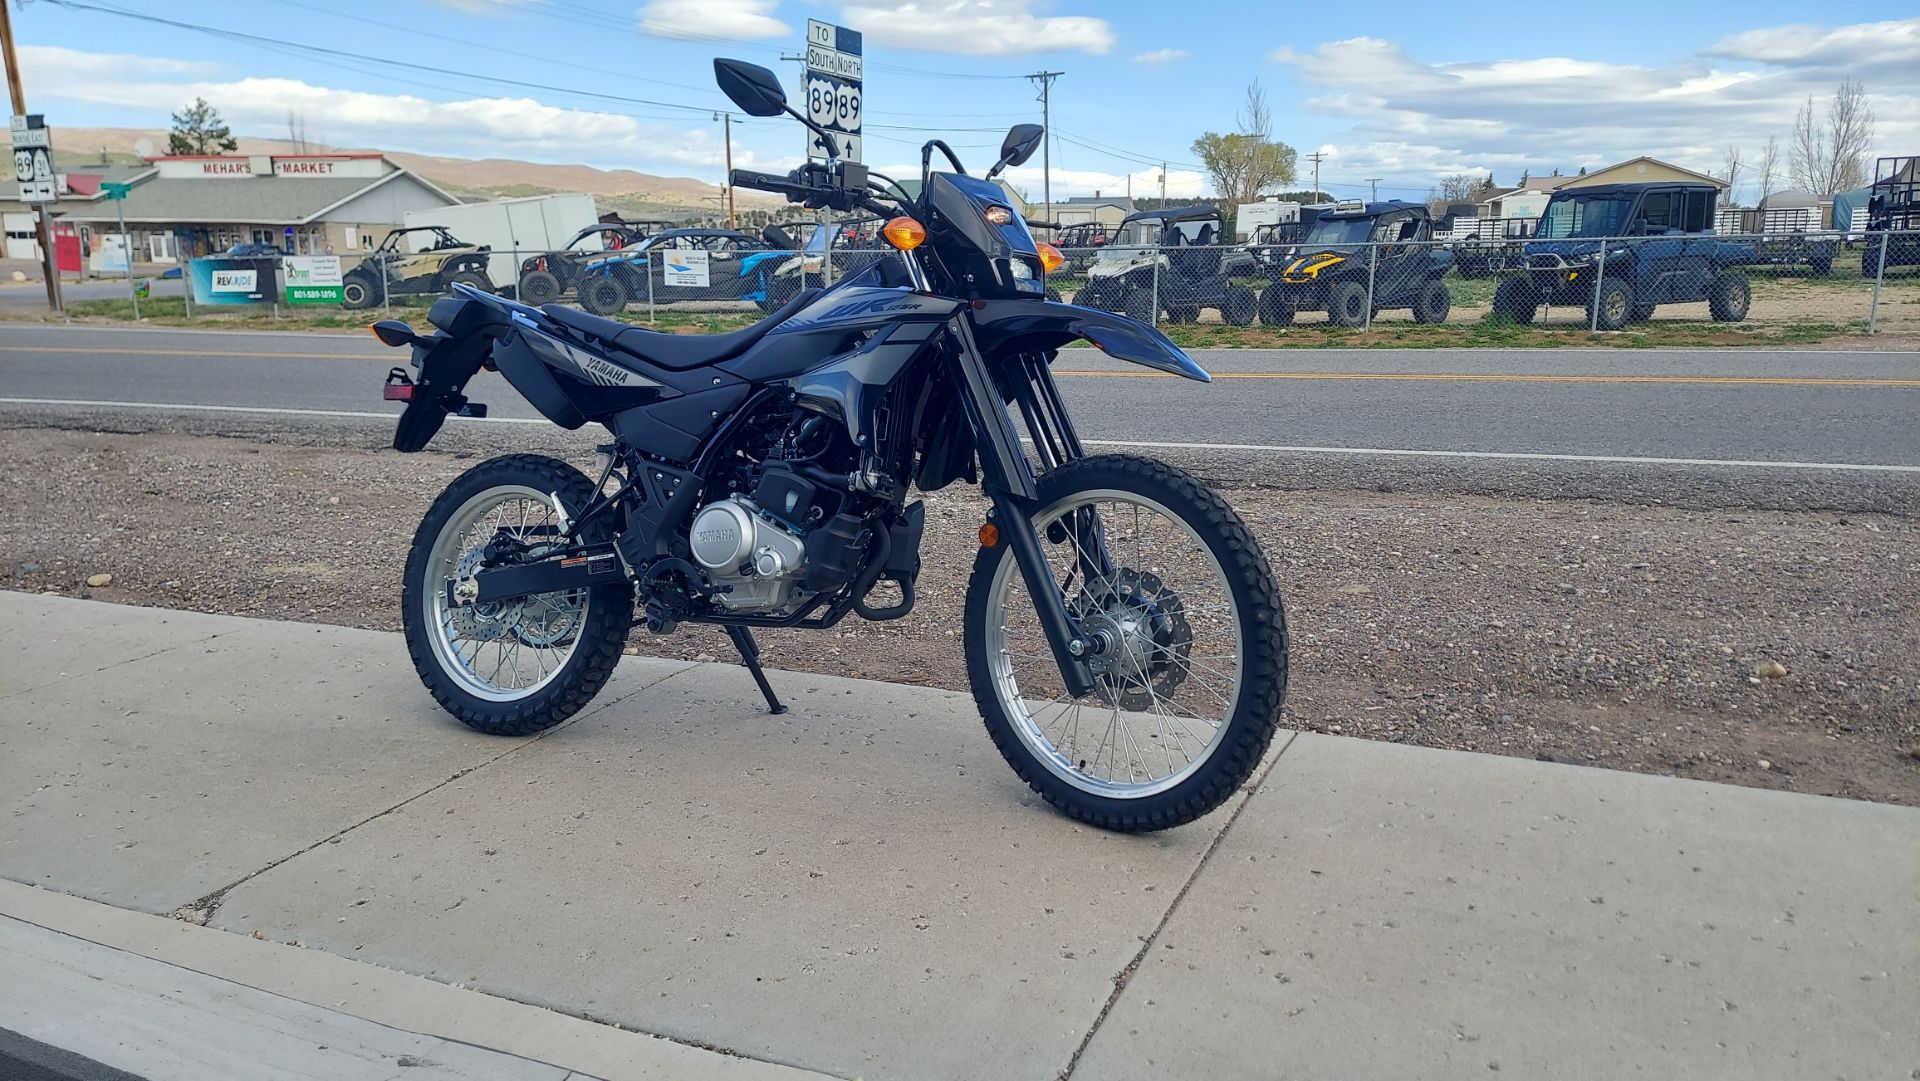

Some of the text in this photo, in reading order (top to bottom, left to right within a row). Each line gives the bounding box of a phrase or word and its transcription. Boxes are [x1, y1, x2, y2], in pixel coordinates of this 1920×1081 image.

[815, 26, 829, 41] TO
[809, 49, 834, 70] SOUTH
[837, 56, 861, 74] NORTH
[812, 87, 833, 115] 89
[839, 95, 859, 120] 89
[16, 157, 31, 173] 89
[203, 162, 334, 174] MEHAR'S MARKET
[586, 357, 629, 384] YAMAHA
[697, 528, 735, 544] YAMAHA
